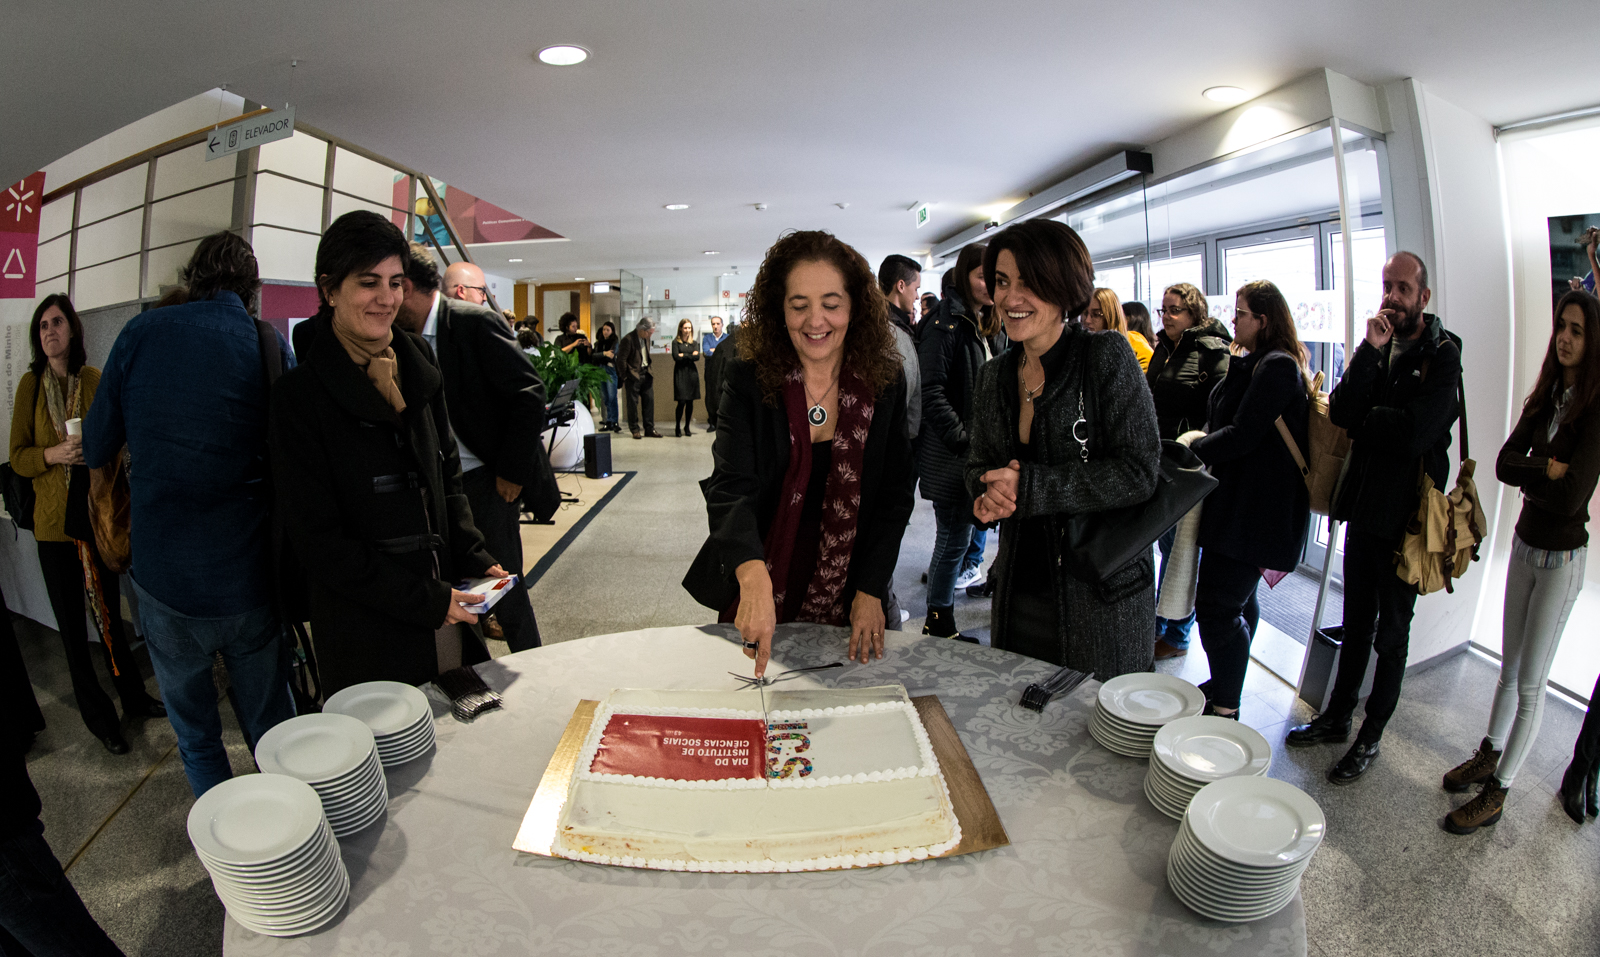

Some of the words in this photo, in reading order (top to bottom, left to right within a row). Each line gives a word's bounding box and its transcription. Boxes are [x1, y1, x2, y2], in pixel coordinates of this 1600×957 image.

[245, 118, 289, 140] ELEVADOR
[6, 363, 12, 377] do
[663, 738, 701, 746] SOCIAIS
[704, 740, 750, 748] CIÊNCIAS
[682, 748, 695, 756] DE
[767, 722, 813, 779] ICS
[714, 758, 729, 766] DO
